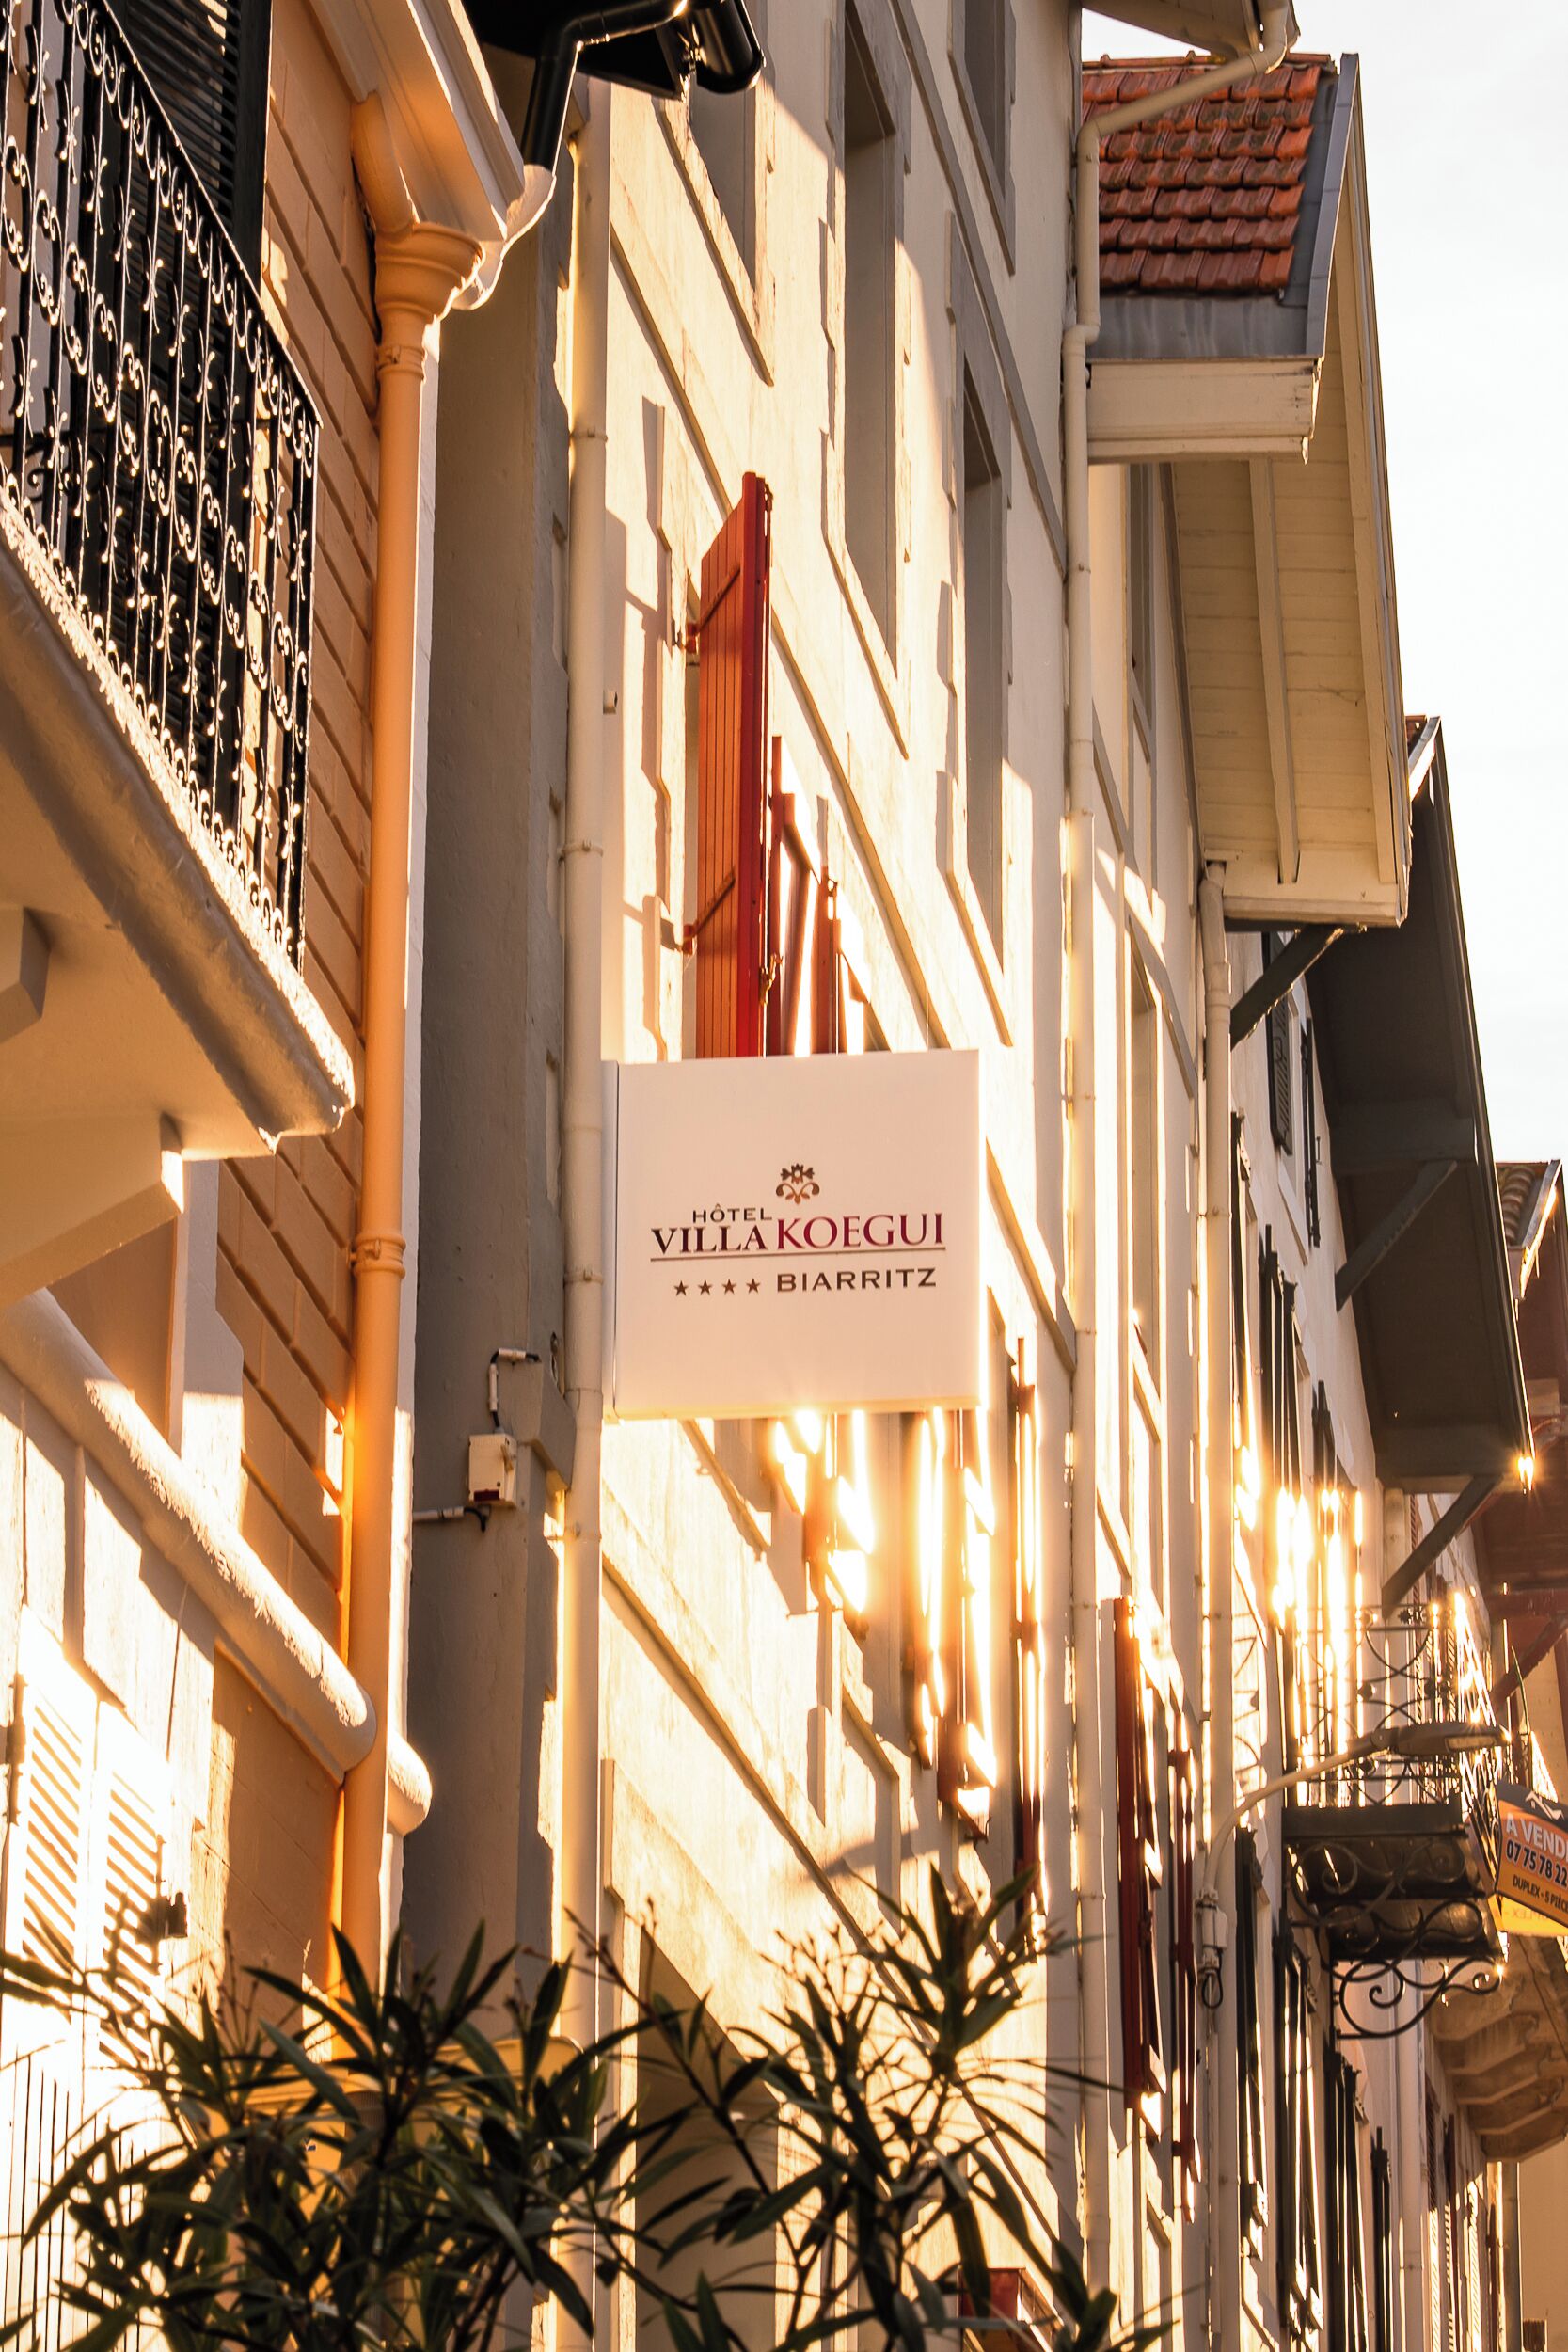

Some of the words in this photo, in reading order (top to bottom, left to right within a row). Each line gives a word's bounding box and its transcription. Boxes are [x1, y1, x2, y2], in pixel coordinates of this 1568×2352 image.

[692, 1203, 772, 1223] HÔTEL
[651, 1225, 768, 1254] VILLA
[777, 1212, 943, 1250] KOEGUI
[777, 1267, 936, 1293] BIARRITZ
[1506, 1813, 1518, 1836] A
[1507, 1839, 1521, 1863] 07
[1524, 1847, 1536, 1870] 75
[1539, 1853, 1552, 1879] 78
[1555, 1862, 1568, 1887] 22
[1513, 1874, 1541, 1899] DUPLEX
[1544, 1892, 1550, 1905] 5
